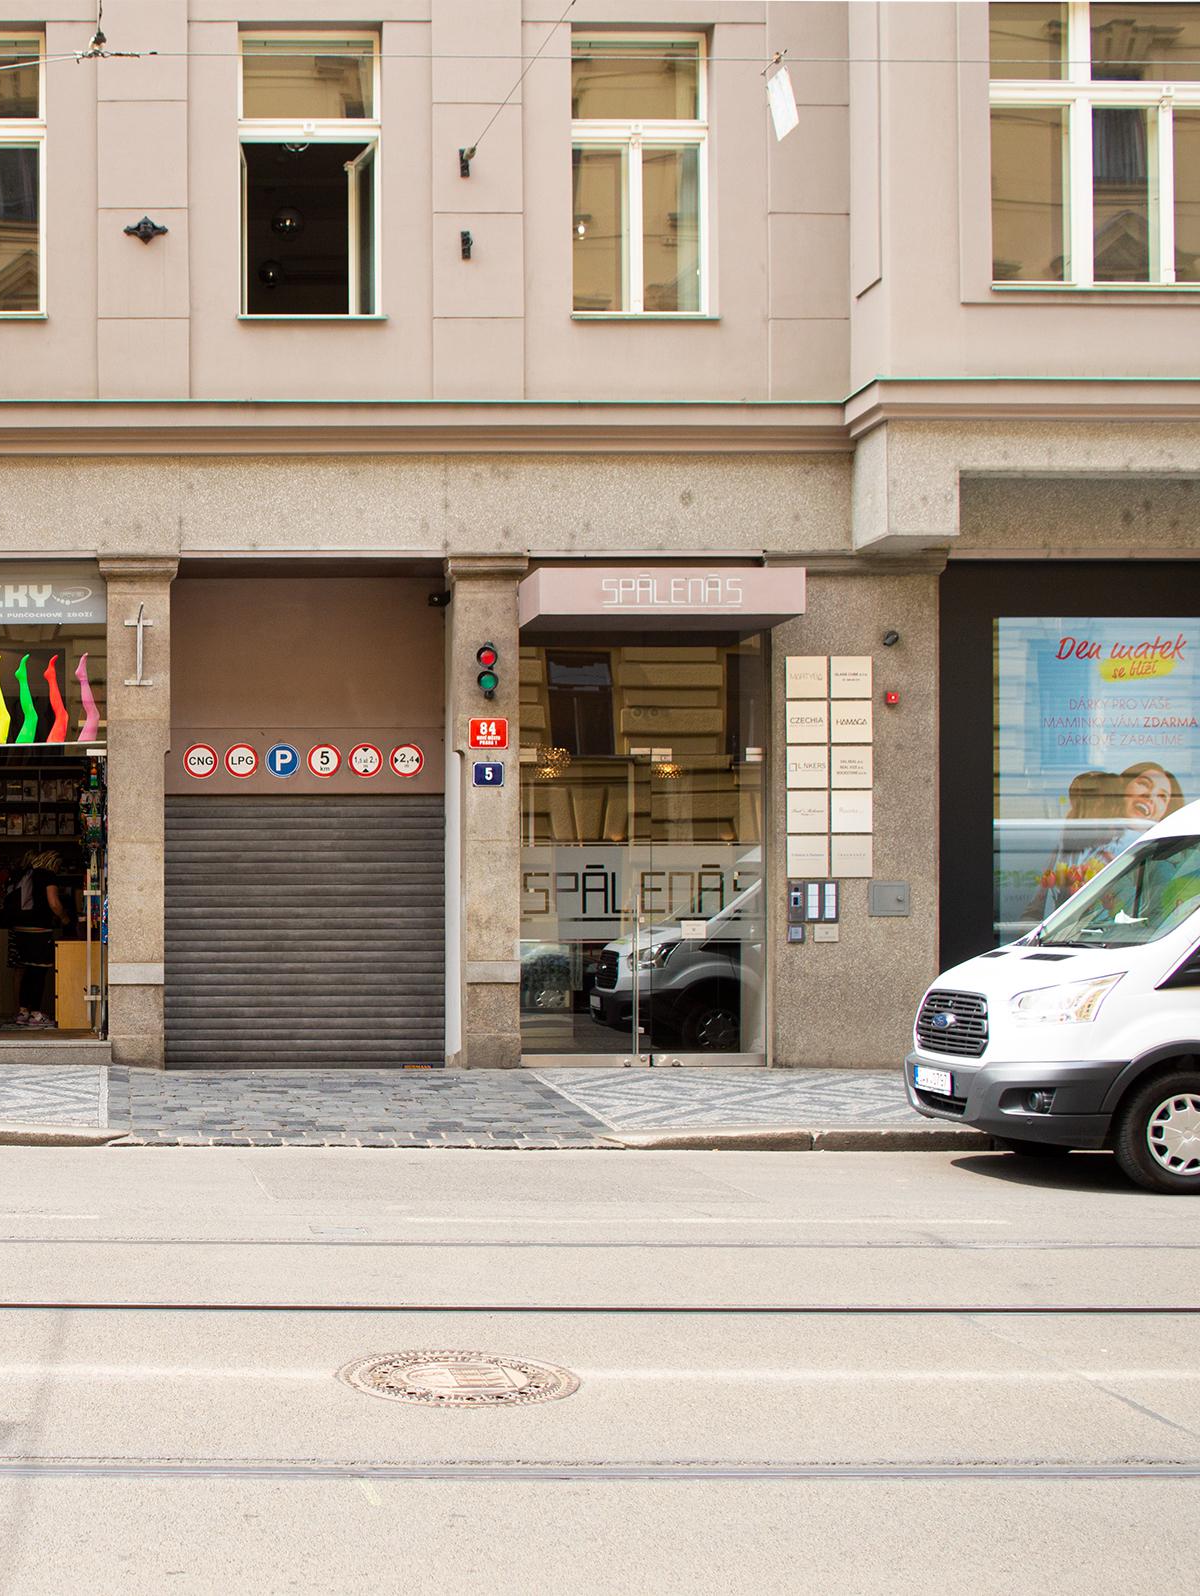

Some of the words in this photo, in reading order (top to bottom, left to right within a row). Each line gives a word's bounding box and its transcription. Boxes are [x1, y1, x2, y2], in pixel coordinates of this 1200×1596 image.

[1055, 636, 1102, 661] Den
[1110, 632, 1188, 661] matek
[1112, 667, 1126, 679] se
[1069, 697, 1108, 710] DÁRKY
[1112, 699, 1137, 710] PRO
[480, 722, 497, 735] 84
[1043, 717, 1106, 728] MAMINKY
[1143, 716, 1199, 728] ZDARMA
[189, 756, 214, 766] CNG
[231, 756, 254, 766] LPG
[275, 750, 293, 771] P
[320, 751, 330, 765] 5
[400, 753, 414, 764] 2,4
[485, 767, 493, 781] 5
